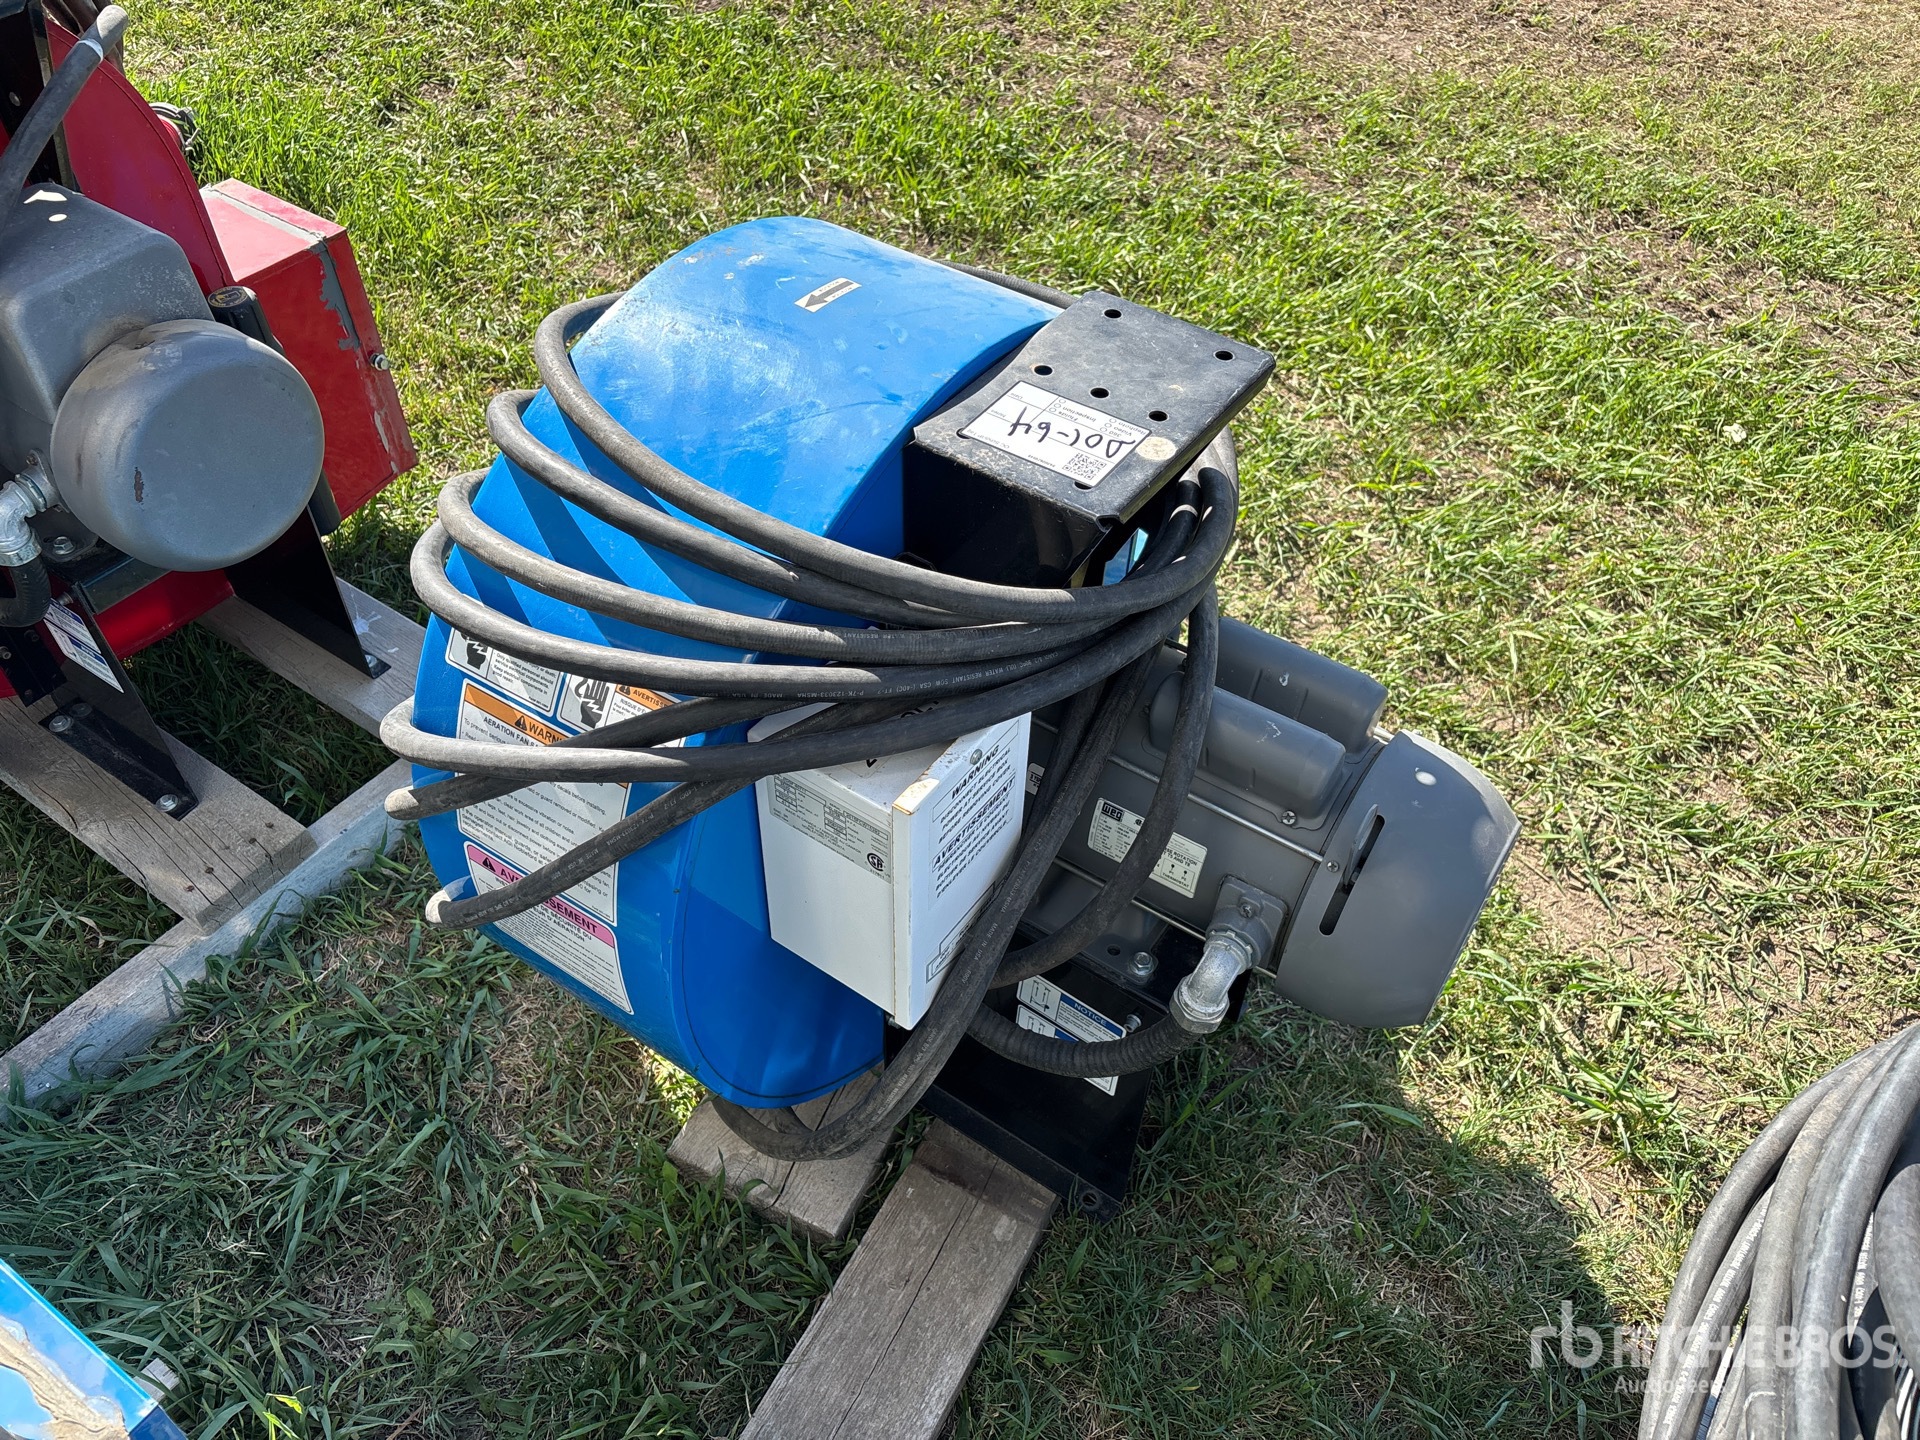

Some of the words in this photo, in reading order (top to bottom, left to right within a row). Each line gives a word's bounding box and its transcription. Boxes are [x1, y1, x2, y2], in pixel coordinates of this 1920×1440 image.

[1060, 406, 1096, 422] Inspection
[1112, 425, 1133, 436] Video
[495, 658, 508, 667] service
[496, 652, 504, 660] Only
[521, 665, 539, 678] personnel
[540, 675, 553, 684] should
[985, 667, 1002, 676] WATER
[494, 664, 502, 672] Keep
[520, 678, 542, 692] components
[952, 672, 981, 682] RESISTANT
[464, 717, 470, 725] To
[483, 716, 515, 738] AERATION
[515, 733, 529, 745] FAN
[952, 743, 999, 799] WARNING
[556, 784, 570, 795] decals
[571, 792, 585, 803] before
[940, 781, 976, 824] DISCONNECT
[978, 746, 1010, 784] ELECTRICAL
[938, 816, 960, 844] BEFORE
[962, 784, 990, 819] REMOVING
[992, 763, 1010, 787] COVER
[942, 805, 962, 831] POWER
[963, 796, 970, 808] AT
[972, 770, 995, 799] SERVICE
[996, 758, 1007, 773] BOX
[540, 794, 552, 804] guard
[553, 801, 571, 814] removed
[538, 810, 556, 824] vibration
[933, 774, 1014, 868] AVERTISSEMENT
[545, 825, 561, 837] children
[561, 835, 569, 843] and
[1173, 851, 1196, 865] ROTATION
[1162, 872, 1188, 887] THERMOSTAT
[540, 905, 548, 913] DE
[582, 931, 591, 940] DU
[985, 922, 997, 938] MADE
[972, 948, 982, 961] USA
[1074, 1003, 1106, 1025] NOTICE
